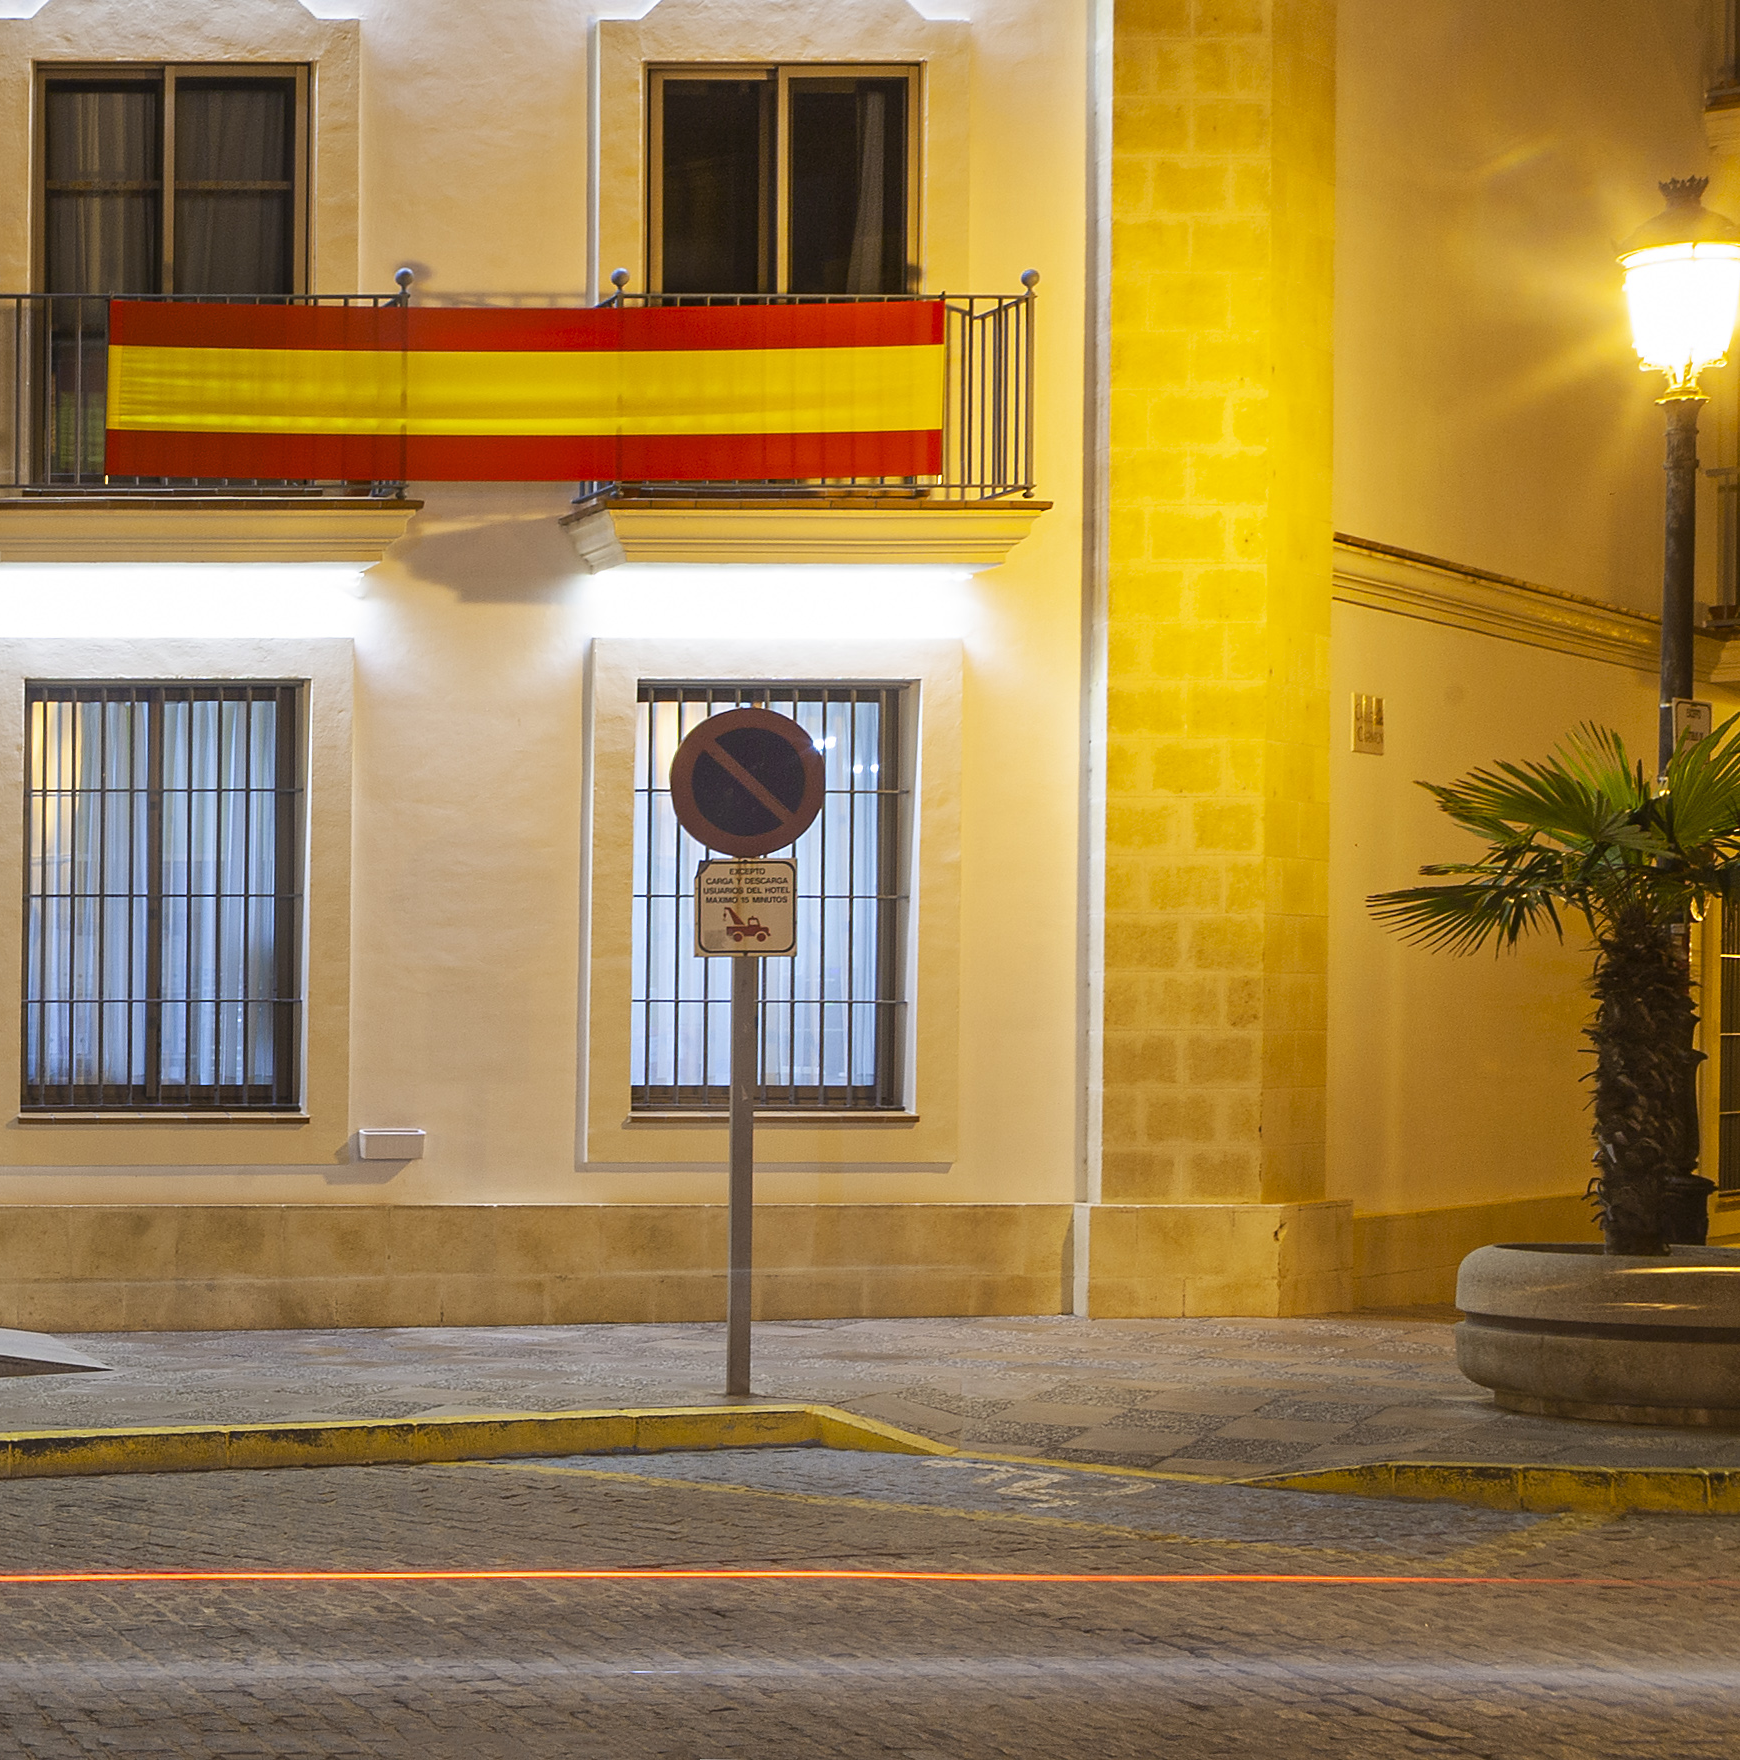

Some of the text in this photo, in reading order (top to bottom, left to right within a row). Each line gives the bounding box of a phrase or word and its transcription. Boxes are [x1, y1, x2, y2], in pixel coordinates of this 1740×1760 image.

[729, 867, 766, 876] EXCEPTO
[705, 877, 789, 885] CARGA Y DESCARGA
[703, 886, 791, 895] USUARIOS DEL HOTEL
[705, 896, 788, 904] MAXIMO 15 MINUTOS
